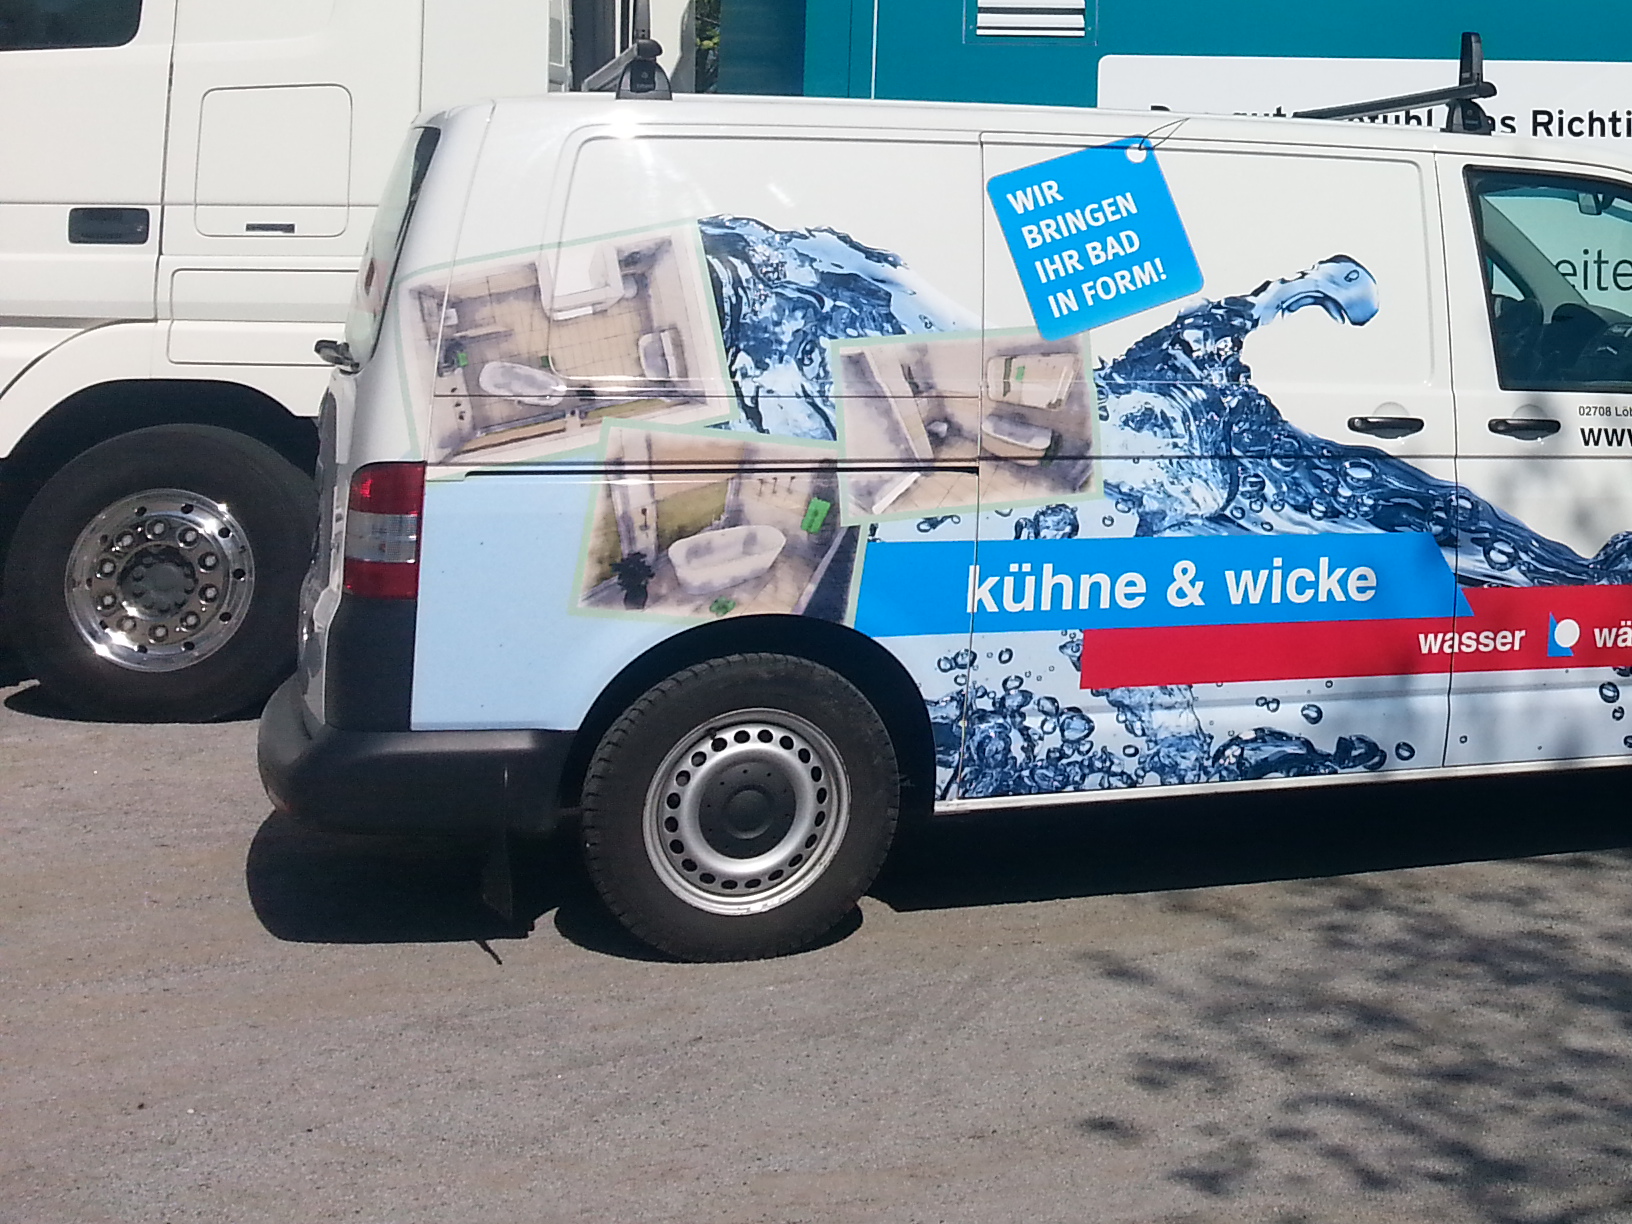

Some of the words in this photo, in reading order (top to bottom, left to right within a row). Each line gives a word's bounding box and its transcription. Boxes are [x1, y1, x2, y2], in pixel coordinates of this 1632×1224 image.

[1007, 180, 1064, 214] WIR
[1021, 192, 1138, 249] BRINGEN
[1034, 249, 1084, 283] IHR
[1085, 230, 1140, 265] BAD
[1048, 289, 1080, 318] IN
[1081, 258, 1167, 306] FORM!
[1578, 406, 1612, 417] 02708
[967, 562, 1147, 613] kühne
[1166, 560, 1205, 607] &
[1224, 557, 1377, 605] wicke
[1418, 629, 1525, 654] wasser
